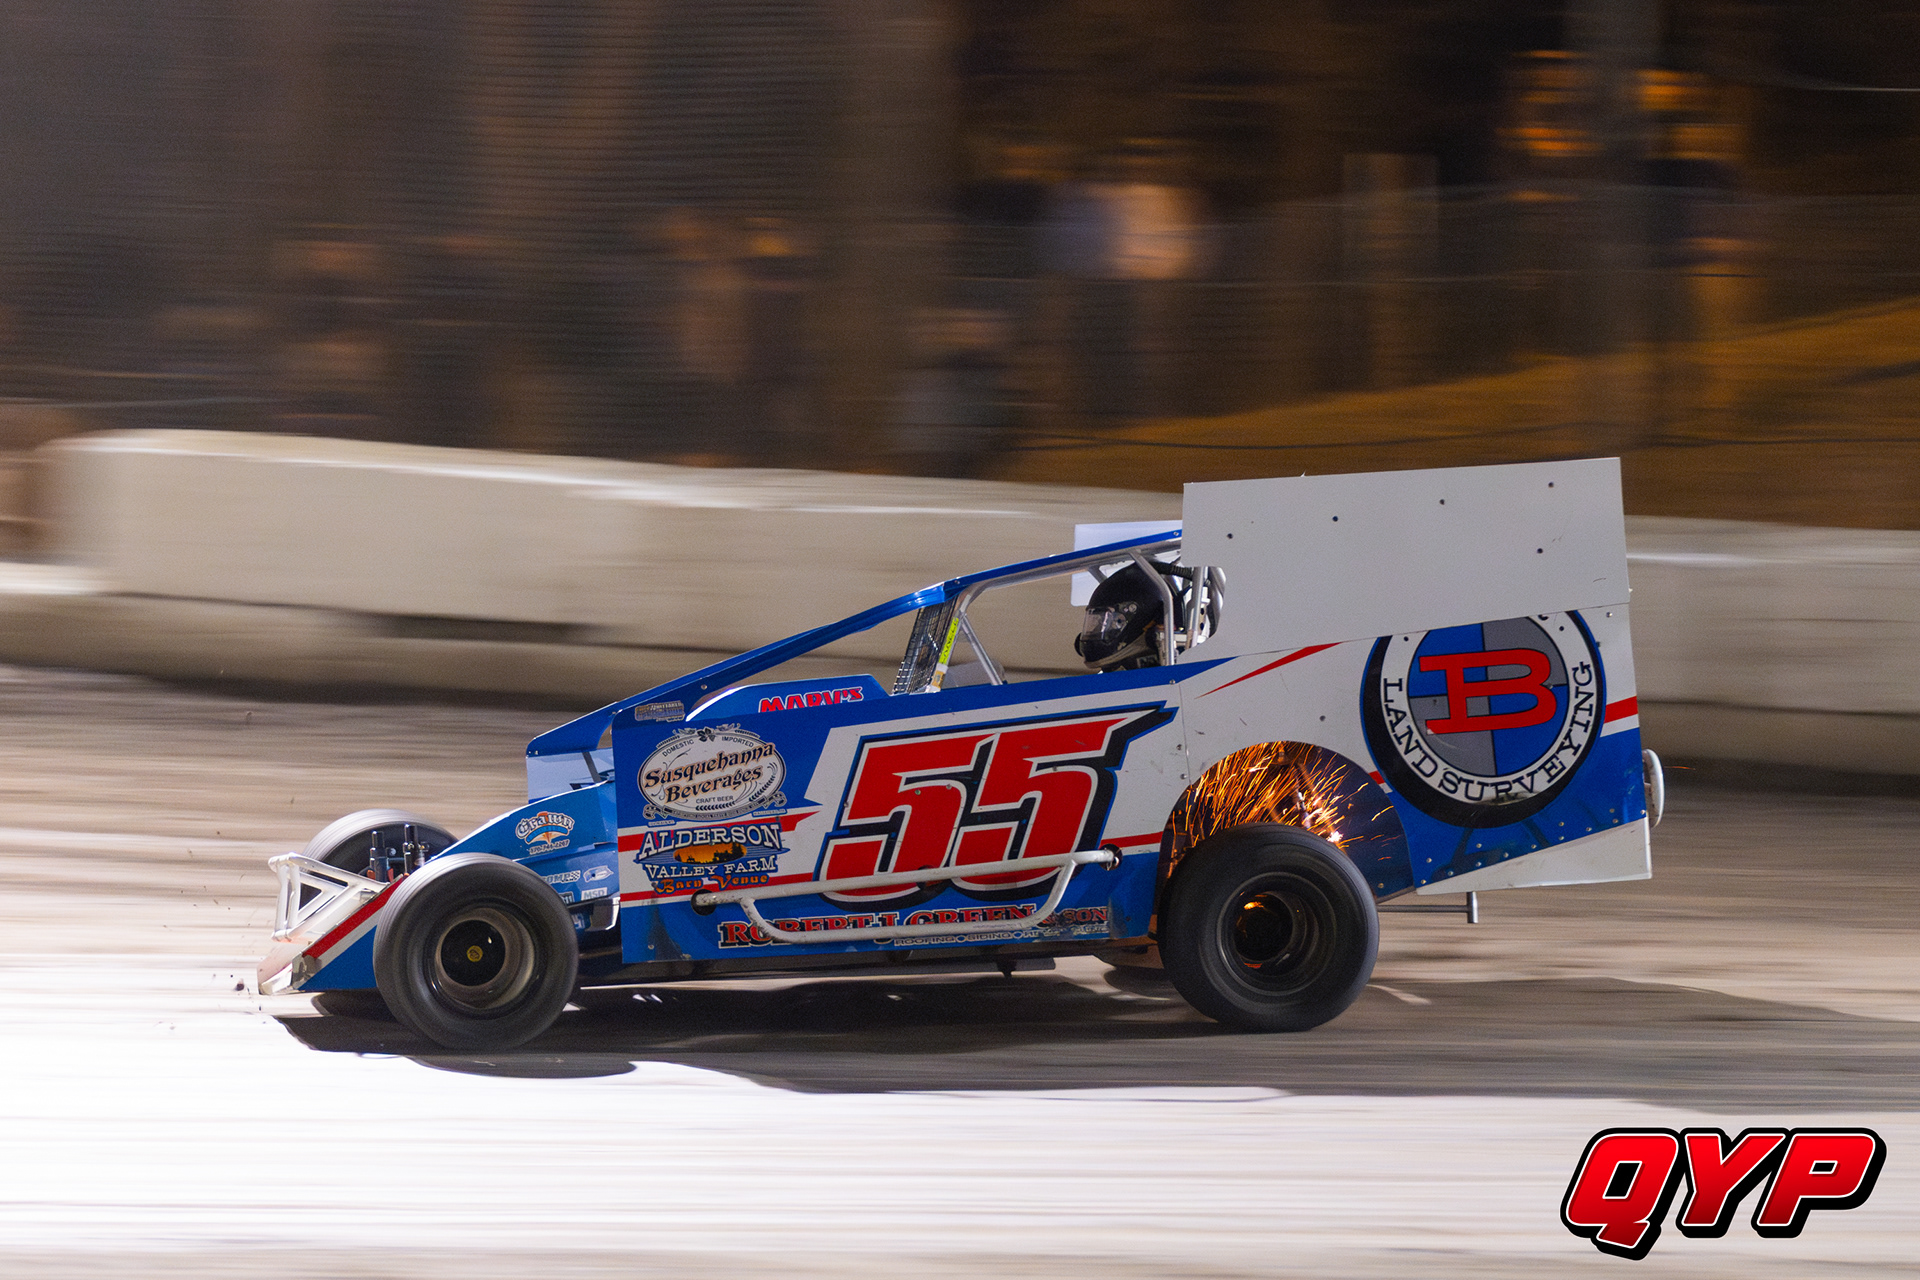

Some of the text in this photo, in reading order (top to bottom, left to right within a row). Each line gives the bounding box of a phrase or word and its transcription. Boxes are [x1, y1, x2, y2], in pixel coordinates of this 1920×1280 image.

[1382, 660, 1595, 802] LAND SURVEYING
[661, 736, 755, 757] DOMESTIC IMPORTED
[643, 742, 776, 789] Susquehanna
[665, 765, 763, 804] Beverages
[695, 796, 715, 804] CRAFT
[816, 707, 1156, 900] 55
[639, 823, 781, 860] ALDERSON
[645, 855, 776, 879] VALLEY FARM
[583, 890, 605, 900] MSD
[655, 874, 768, 893] Barn Venue
